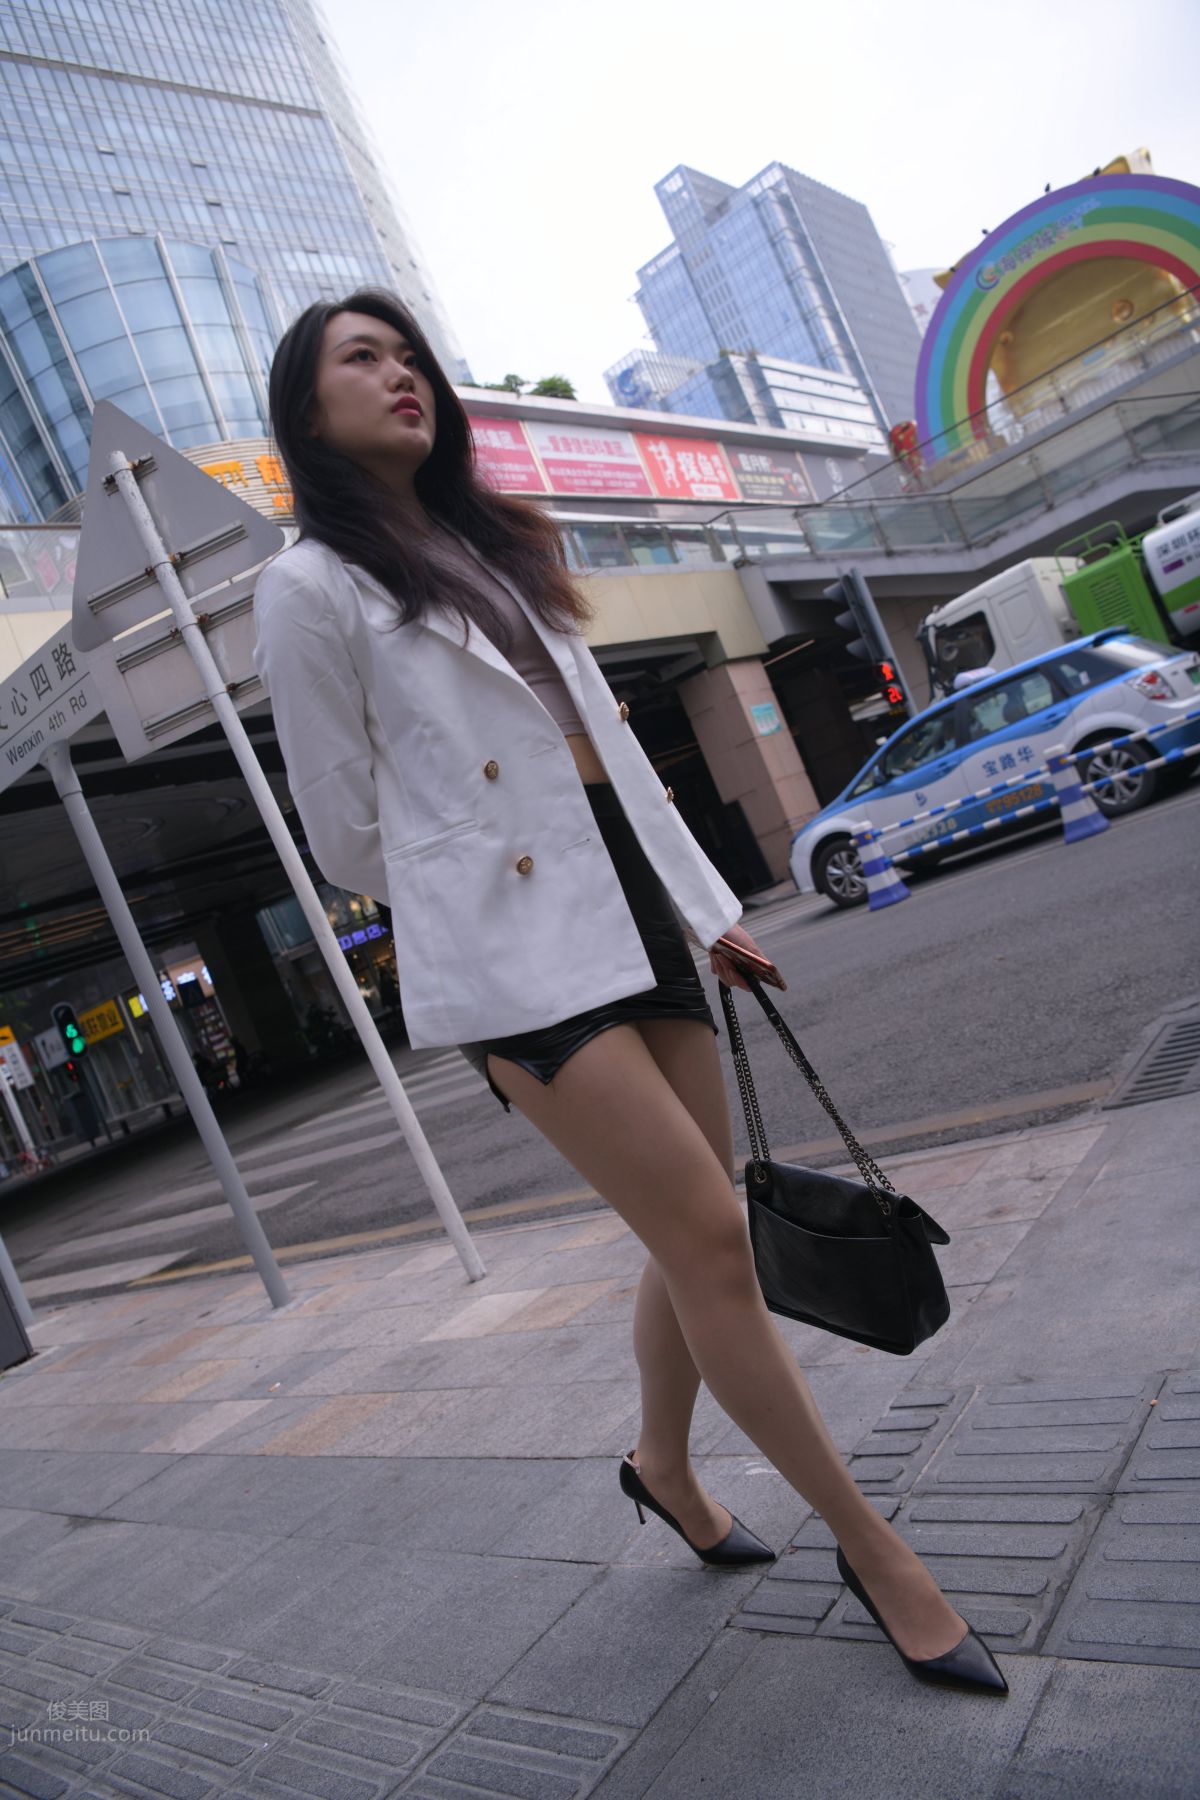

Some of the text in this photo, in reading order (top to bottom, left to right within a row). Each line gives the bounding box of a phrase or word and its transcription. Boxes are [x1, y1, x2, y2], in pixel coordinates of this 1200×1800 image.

[6, 690, 87, 765] Wenxin 4th Rd
[982, 745, 1035, 778] 宝路华
